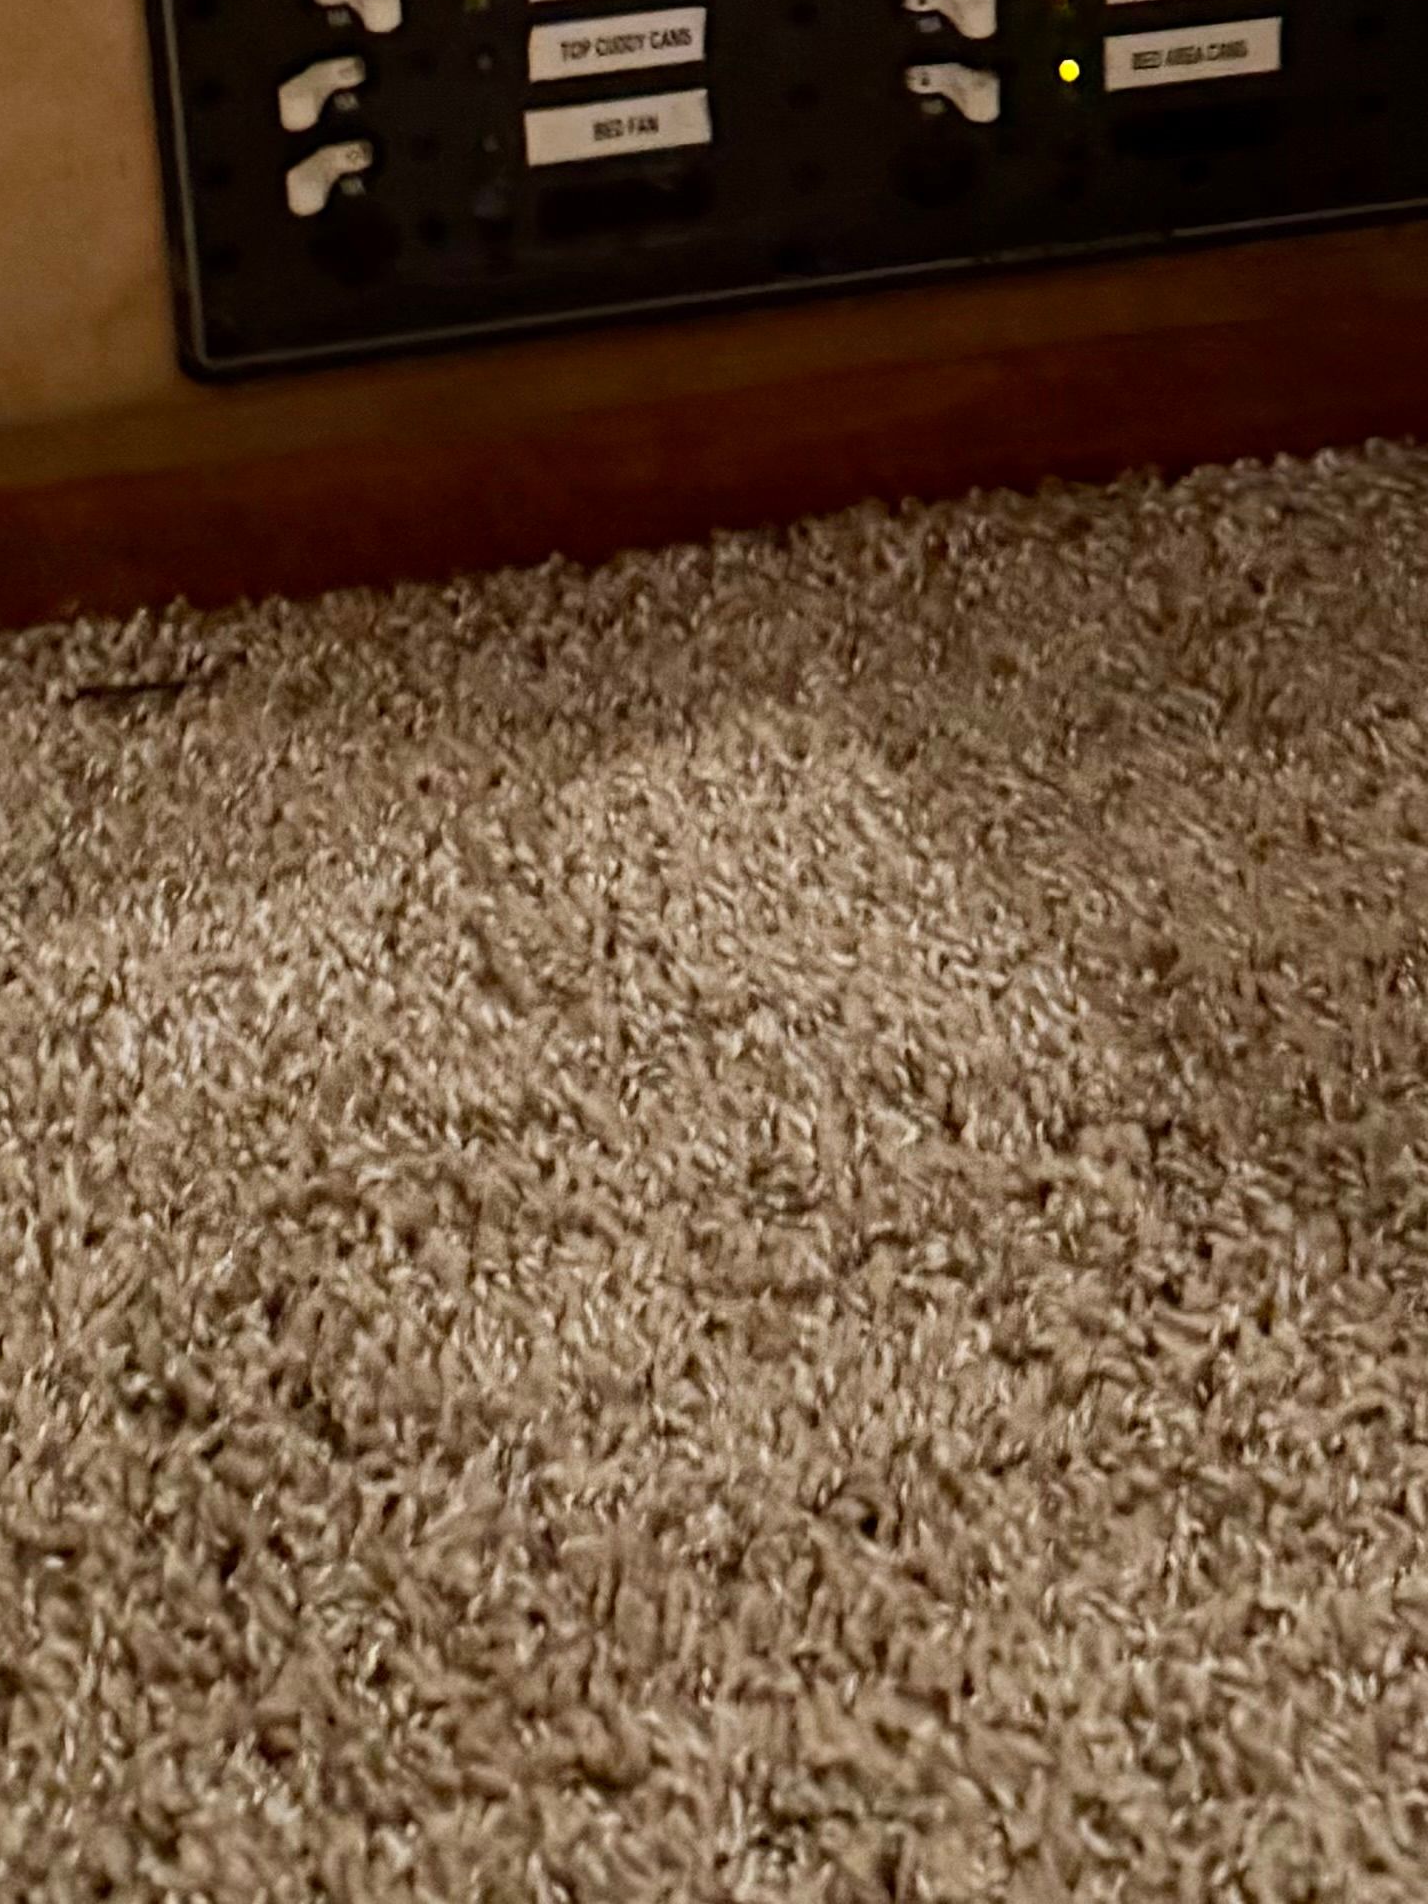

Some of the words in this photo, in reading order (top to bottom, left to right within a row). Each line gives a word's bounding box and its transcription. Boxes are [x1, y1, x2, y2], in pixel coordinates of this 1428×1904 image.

[560, 40, 592, 62] TOP
[650, 28, 693, 49] CANS
[593, 120, 623, 142] BED
[627, 114, 659, 136] FAN
